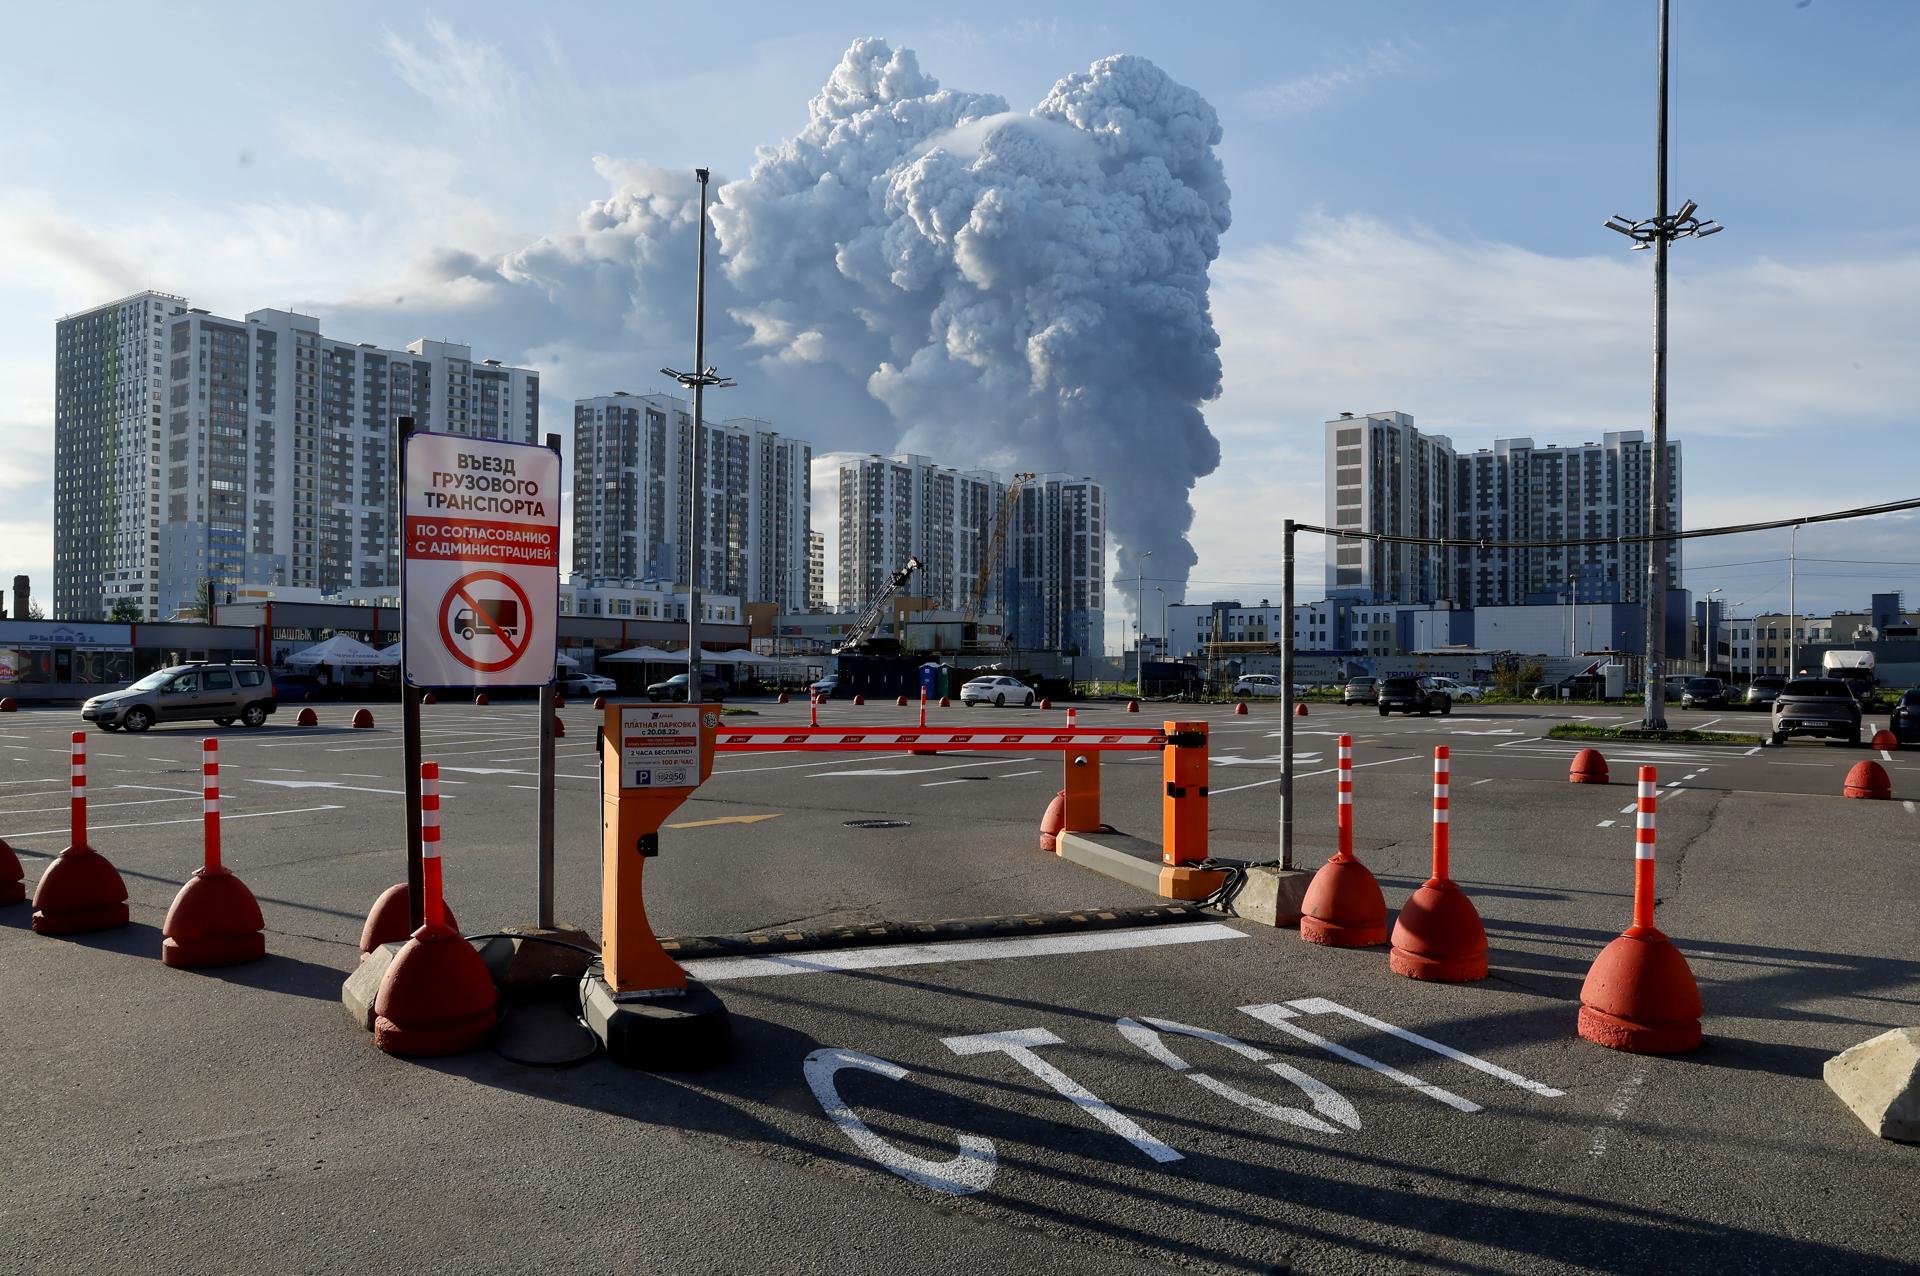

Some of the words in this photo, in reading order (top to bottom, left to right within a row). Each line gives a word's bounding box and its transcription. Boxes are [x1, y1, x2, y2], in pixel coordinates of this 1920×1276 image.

[457, 452, 516, 477] ВЪЕЗД
[432, 471, 539, 496] ГРУЗОВОГО
[424, 491, 545, 517] ТРАНСПОРТА
[416, 524, 438, 538] ПО
[441, 525, 551, 545] СОГЛАСОВАНИЮ
[415, 541, 426, 553] С
[430, 541, 551, 561] АДМИНИСТРАЦИЕЙ
[29, 634, 74, 642] РЫБА
[273, 627, 312, 641] ШАШЛЫК
[318, 629, 329, 641] НА
[674, 772, 684, 781] 50
[803, 996, 1567, 1196] СТОП
